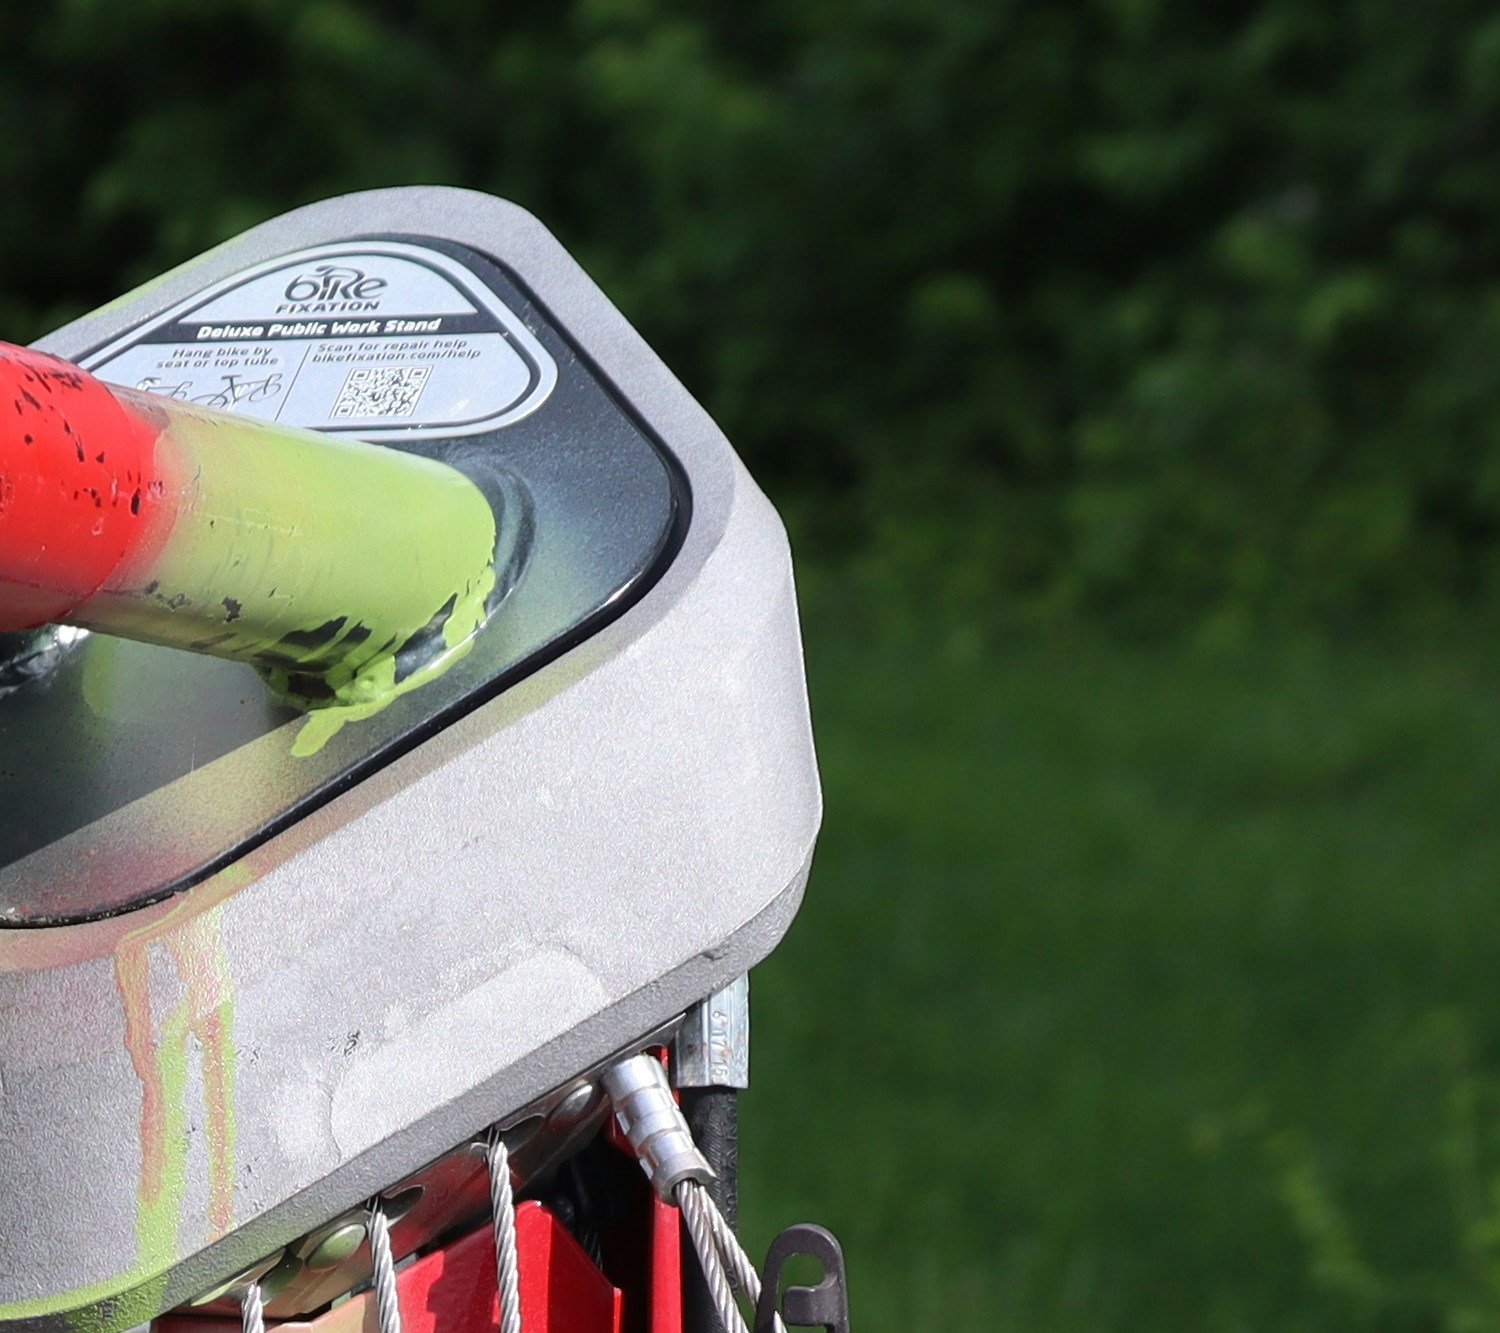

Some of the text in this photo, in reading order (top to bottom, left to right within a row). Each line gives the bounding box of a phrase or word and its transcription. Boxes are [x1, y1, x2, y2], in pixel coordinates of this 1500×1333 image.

[275, 301, 381, 314] FIXATION
[197, 318, 442, 339] Deluxe Public Work Stand
[172, 346, 273, 358] Hang bike by
[318, 339, 467, 352] Scan for repair help
[156, 356, 279, 369] seat or top tube
[312, 349, 481, 363] bikefixation.com/help
